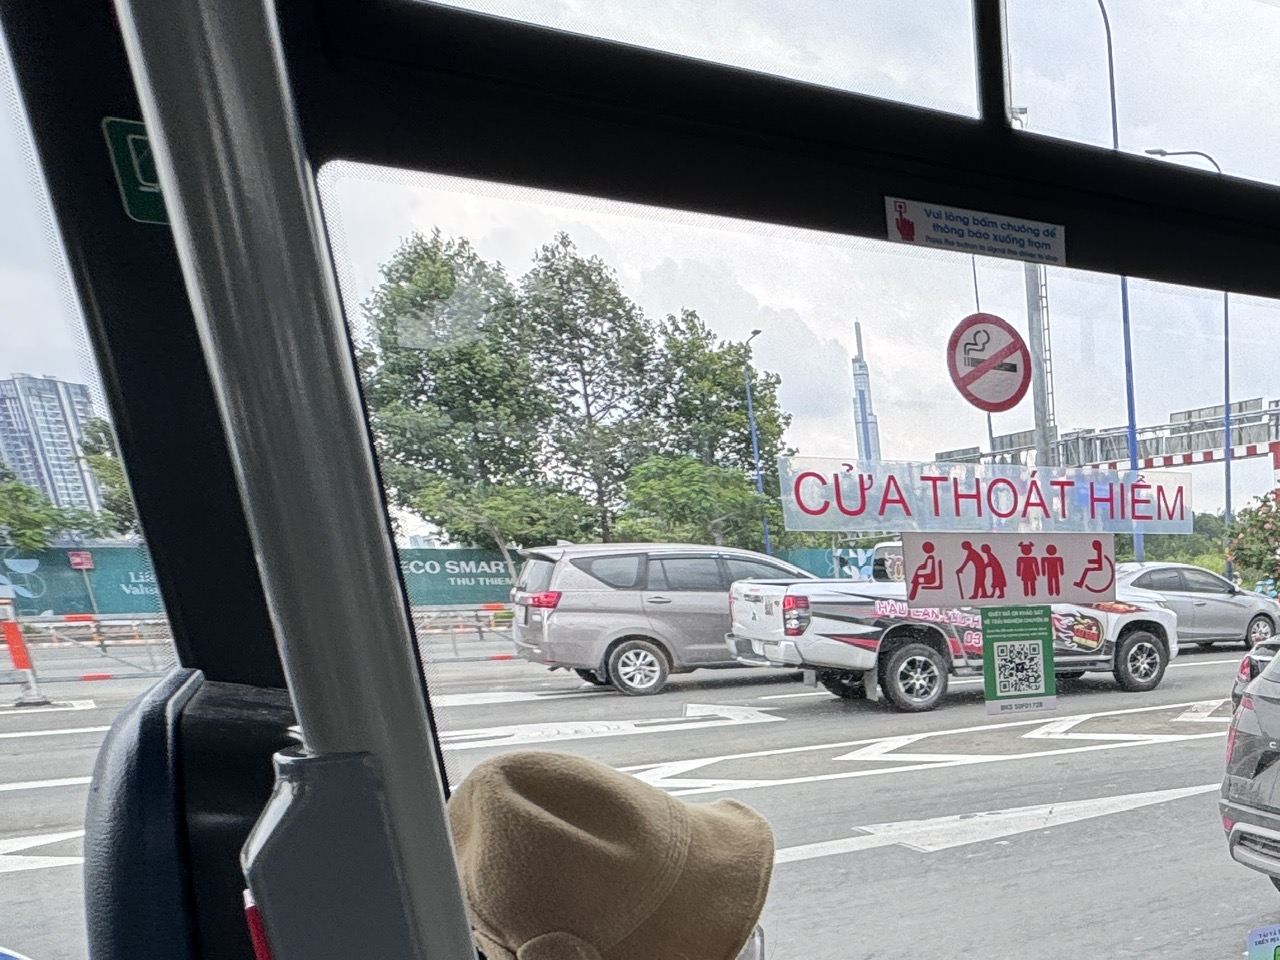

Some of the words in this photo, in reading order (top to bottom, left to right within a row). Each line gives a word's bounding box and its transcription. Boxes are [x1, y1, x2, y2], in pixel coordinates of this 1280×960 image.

[924, 208, 943, 220] Vui
[945, 210, 970, 226] lòng
[972, 215, 998, 229] bấm
[1000, 221, 1040, 238] chuông
[1043, 226, 1057, 238] để
[932, 223, 965, 238] thông
[968, 228, 990, 240] báo
[992, 233, 1025, 248] xuống
[1028, 238, 1051, 251] trạm
[794, 463, 912, 517] CỬA
[920, 470, 1076, 519] THOÁT
[1089, 474, 1185, 521] HIỂM
[448, 577, 476, 586] THU
[1001, 703, 1014, 711] BKS
